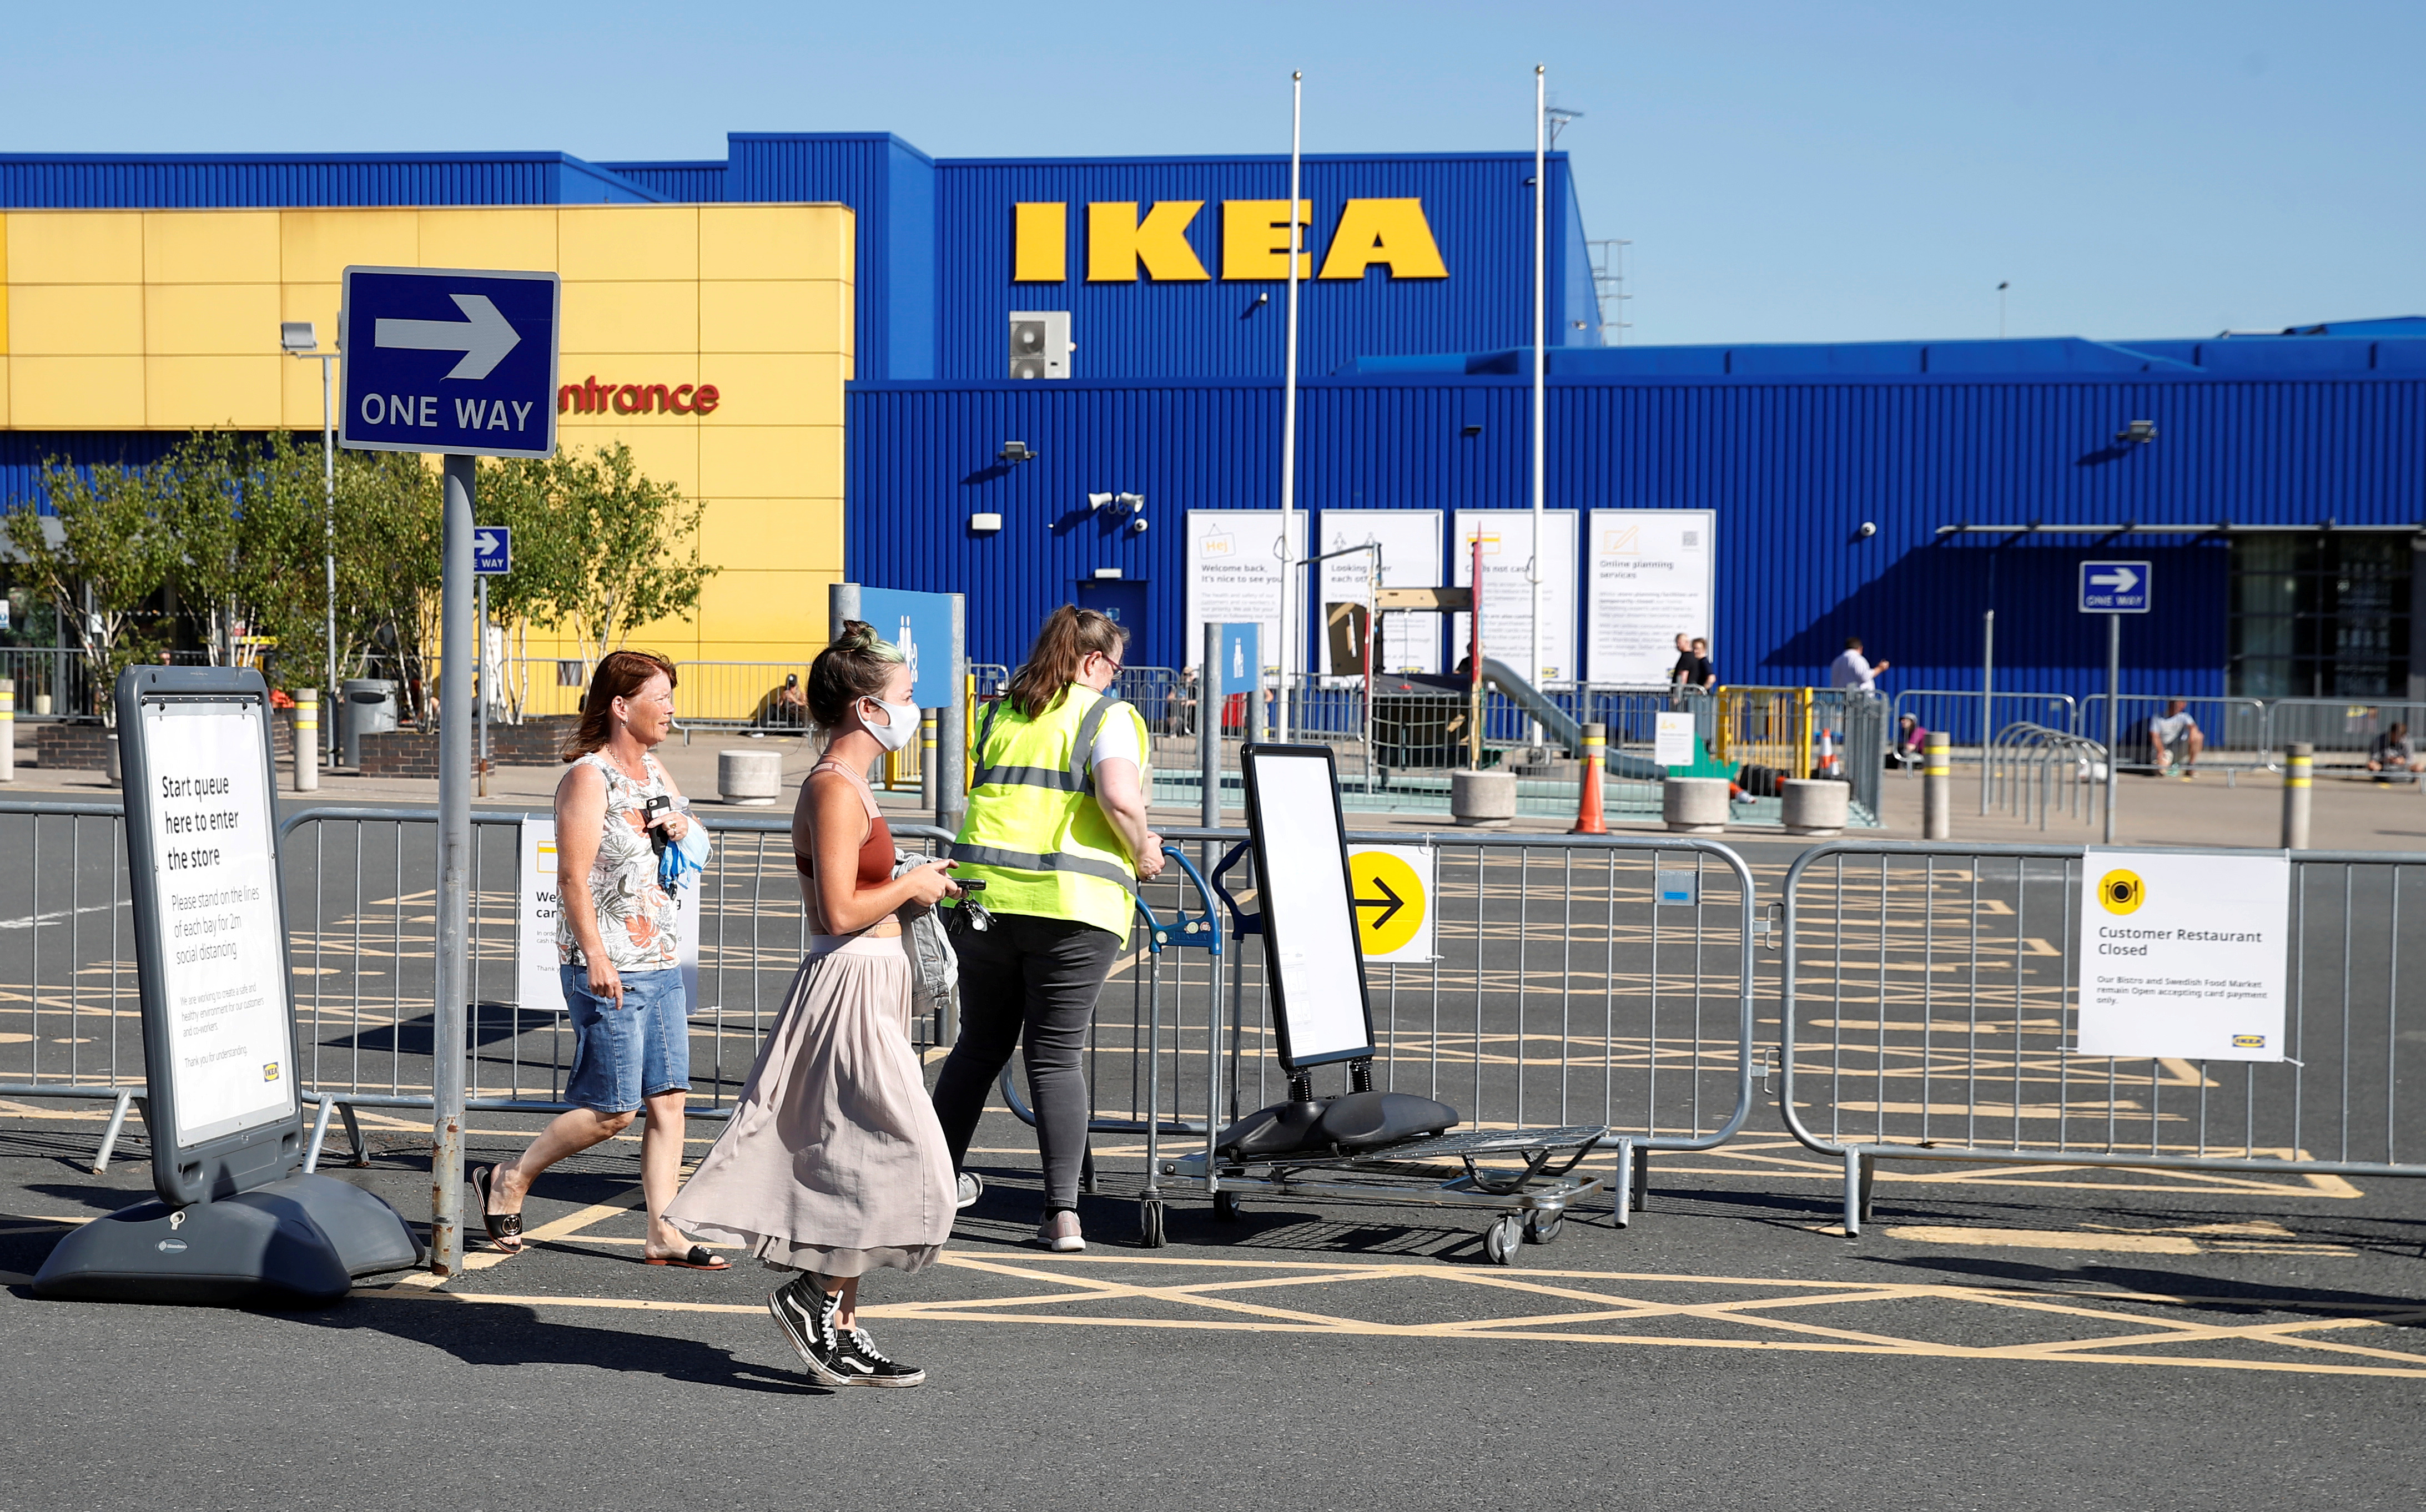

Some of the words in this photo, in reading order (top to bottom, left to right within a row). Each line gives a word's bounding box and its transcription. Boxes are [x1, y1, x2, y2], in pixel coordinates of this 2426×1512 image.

[1013, 197, 1449, 281] IKEA
[558, 375, 720, 412] ntrance
[360, 392, 439, 427] ONE
[454, 397, 533, 432] WAY
[1206, 538, 1229, 553] Hej
[481, 558, 504, 568] WAY
[1244, 564, 1268, 573] back,
[1331, 564, 1367, 573] Looking
[1632, 560, 1674, 570] planning
[2085, 594, 2113, 606] ONE
[2115, 594, 2144, 606] WAY
[162, 775, 192, 798] Start
[194, 777, 229, 803] queue
[165, 811, 193, 834] here
[195, 812, 207, 831] to
[210, 809, 239, 830] enter
[168, 846, 188, 870] the
[191, 847, 220, 868] store
[172, 893, 197, 911] Please
[198, 888, 219, 908] stand
[220, 891, 230, 905] on
[230, 885, 243, 904] the
[243, 884, 260, 901] lines
[536, 891, 556, 903] We
[536, 909, 557, 918] car
[174, 919, 183, 938] of
[184, 917, 202, 936] each
[203, 916, 217, 938] bay
[217, 914, 229, 931] for
[229, 913, 242, 930] 2m
[2098, 926, 2173, 940] Customer
[2176, 929, 2263, 943] Restaurant
[176, 945, 198, 965] social
[199, 940, 238, 960] distancing
[2098, 943, 2148, 956] Closed
[2117, 976, 2144, 984] Bistro
[2165, 977, 2203, 986] Swedish
[2204, 979, 2227, 987] Food
[2228, 980, 2262, 988] Market
[180, 996, 188, 1006] We
[188, 996, 197, 1005] are
[197, 991, 217, 1004] working
[216, 991, 222, 1000] to
[239, 984, 248, 995] safe
[248, 981, 257, 993] and
[2131, 987, 2156, 996] Open
[2157, 988, 2202, 998] accepting
[2204, 989, 2225, 997] card
[2226, 991, 2268, 1000] payment
[181, 1009, 199, 1022] healthy
[200, 1003, 228, 1019] environment
[183, 1026, 193, 1037] and
[184, 1055, 200, 1068] Thank
[199, 1055, 209, 1068] you
[264, 1066, 278, 1077] IKEA
